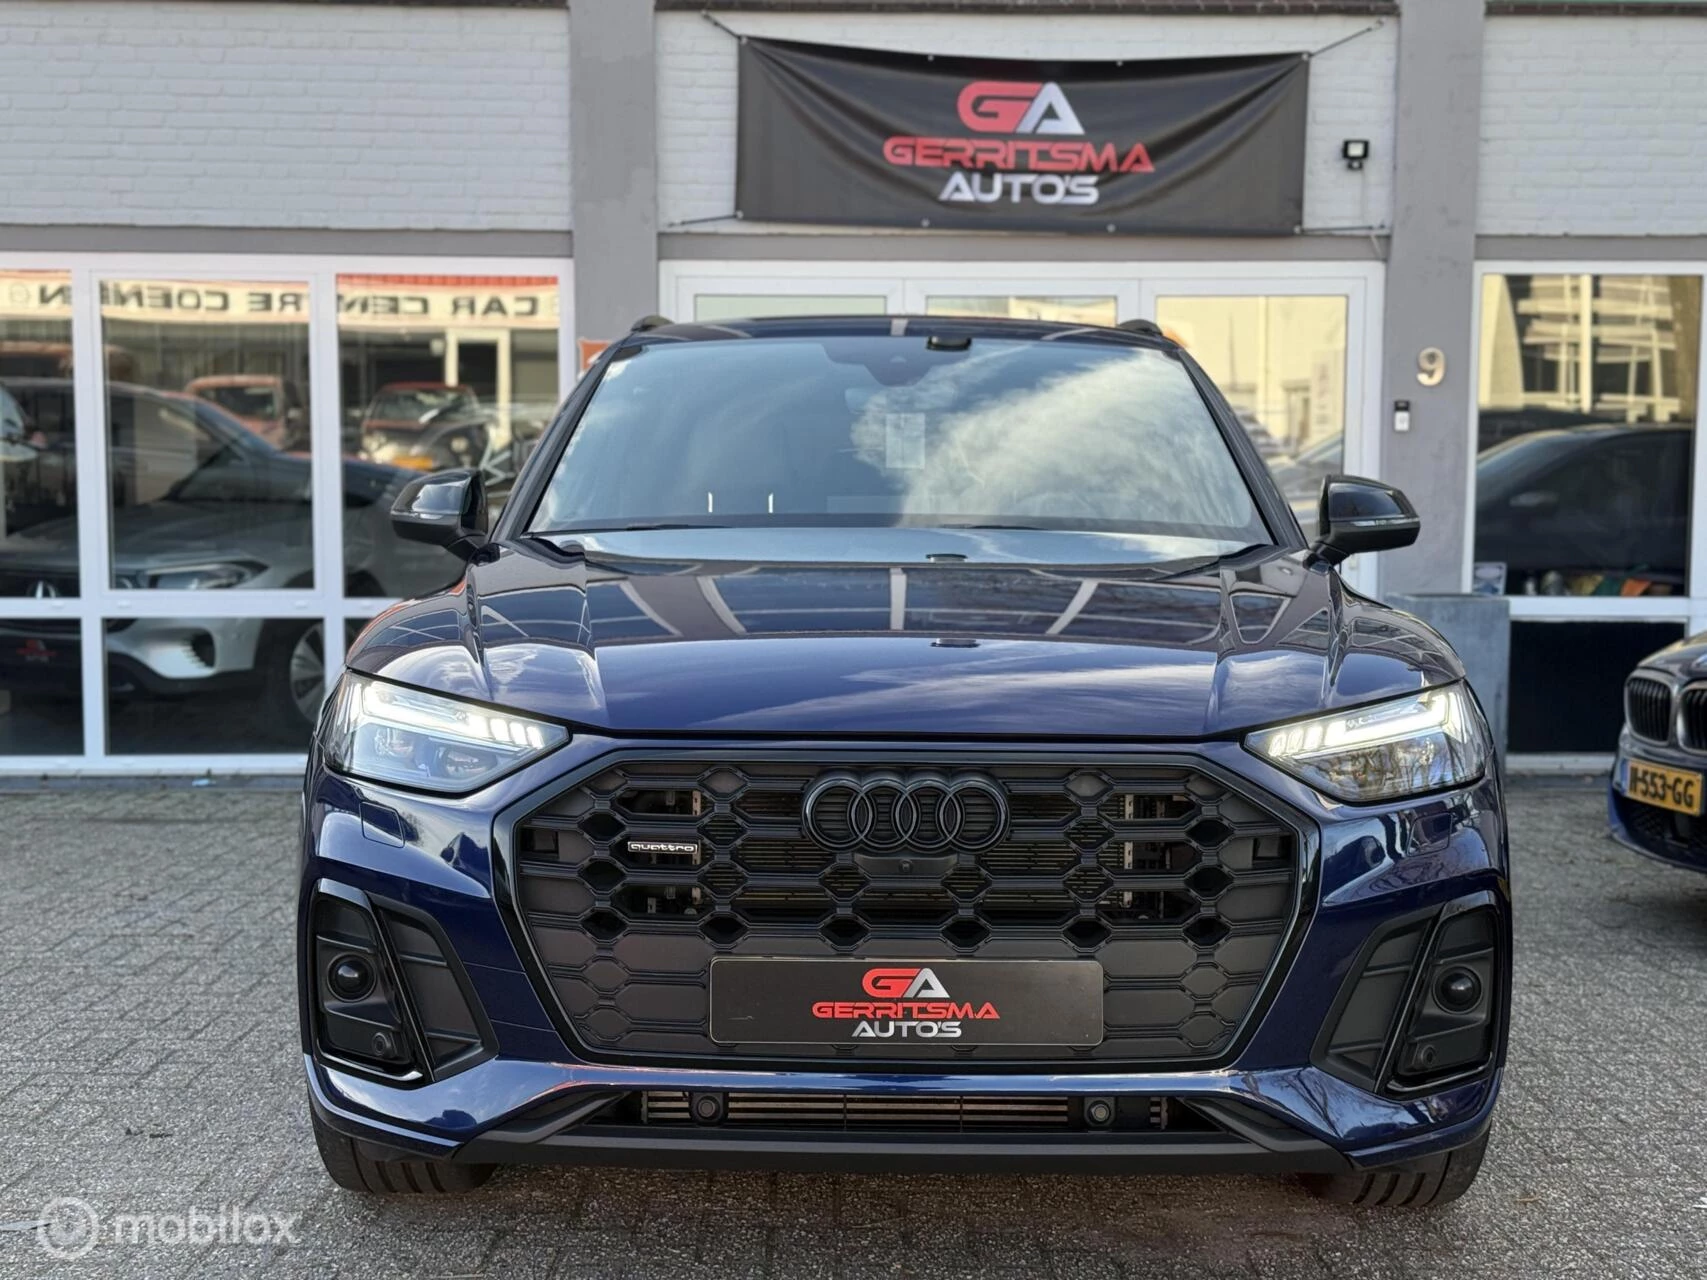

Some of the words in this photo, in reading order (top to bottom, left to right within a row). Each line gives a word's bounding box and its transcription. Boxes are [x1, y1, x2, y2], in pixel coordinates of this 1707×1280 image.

[957, 80, 1085, 134] GA
[883, 136, 1155, 173] GERRITSMA
[938, 171, 1099, 205] AUTO'S
[1416, 347, 1445, 386] 9
[630, 843, 695, 853] quattro
[862, 967, 950, 999] GA
[812, 1002, 1000, 1019] GERRITSMA
[851, 1020, 963, 1038] AUTO'S
